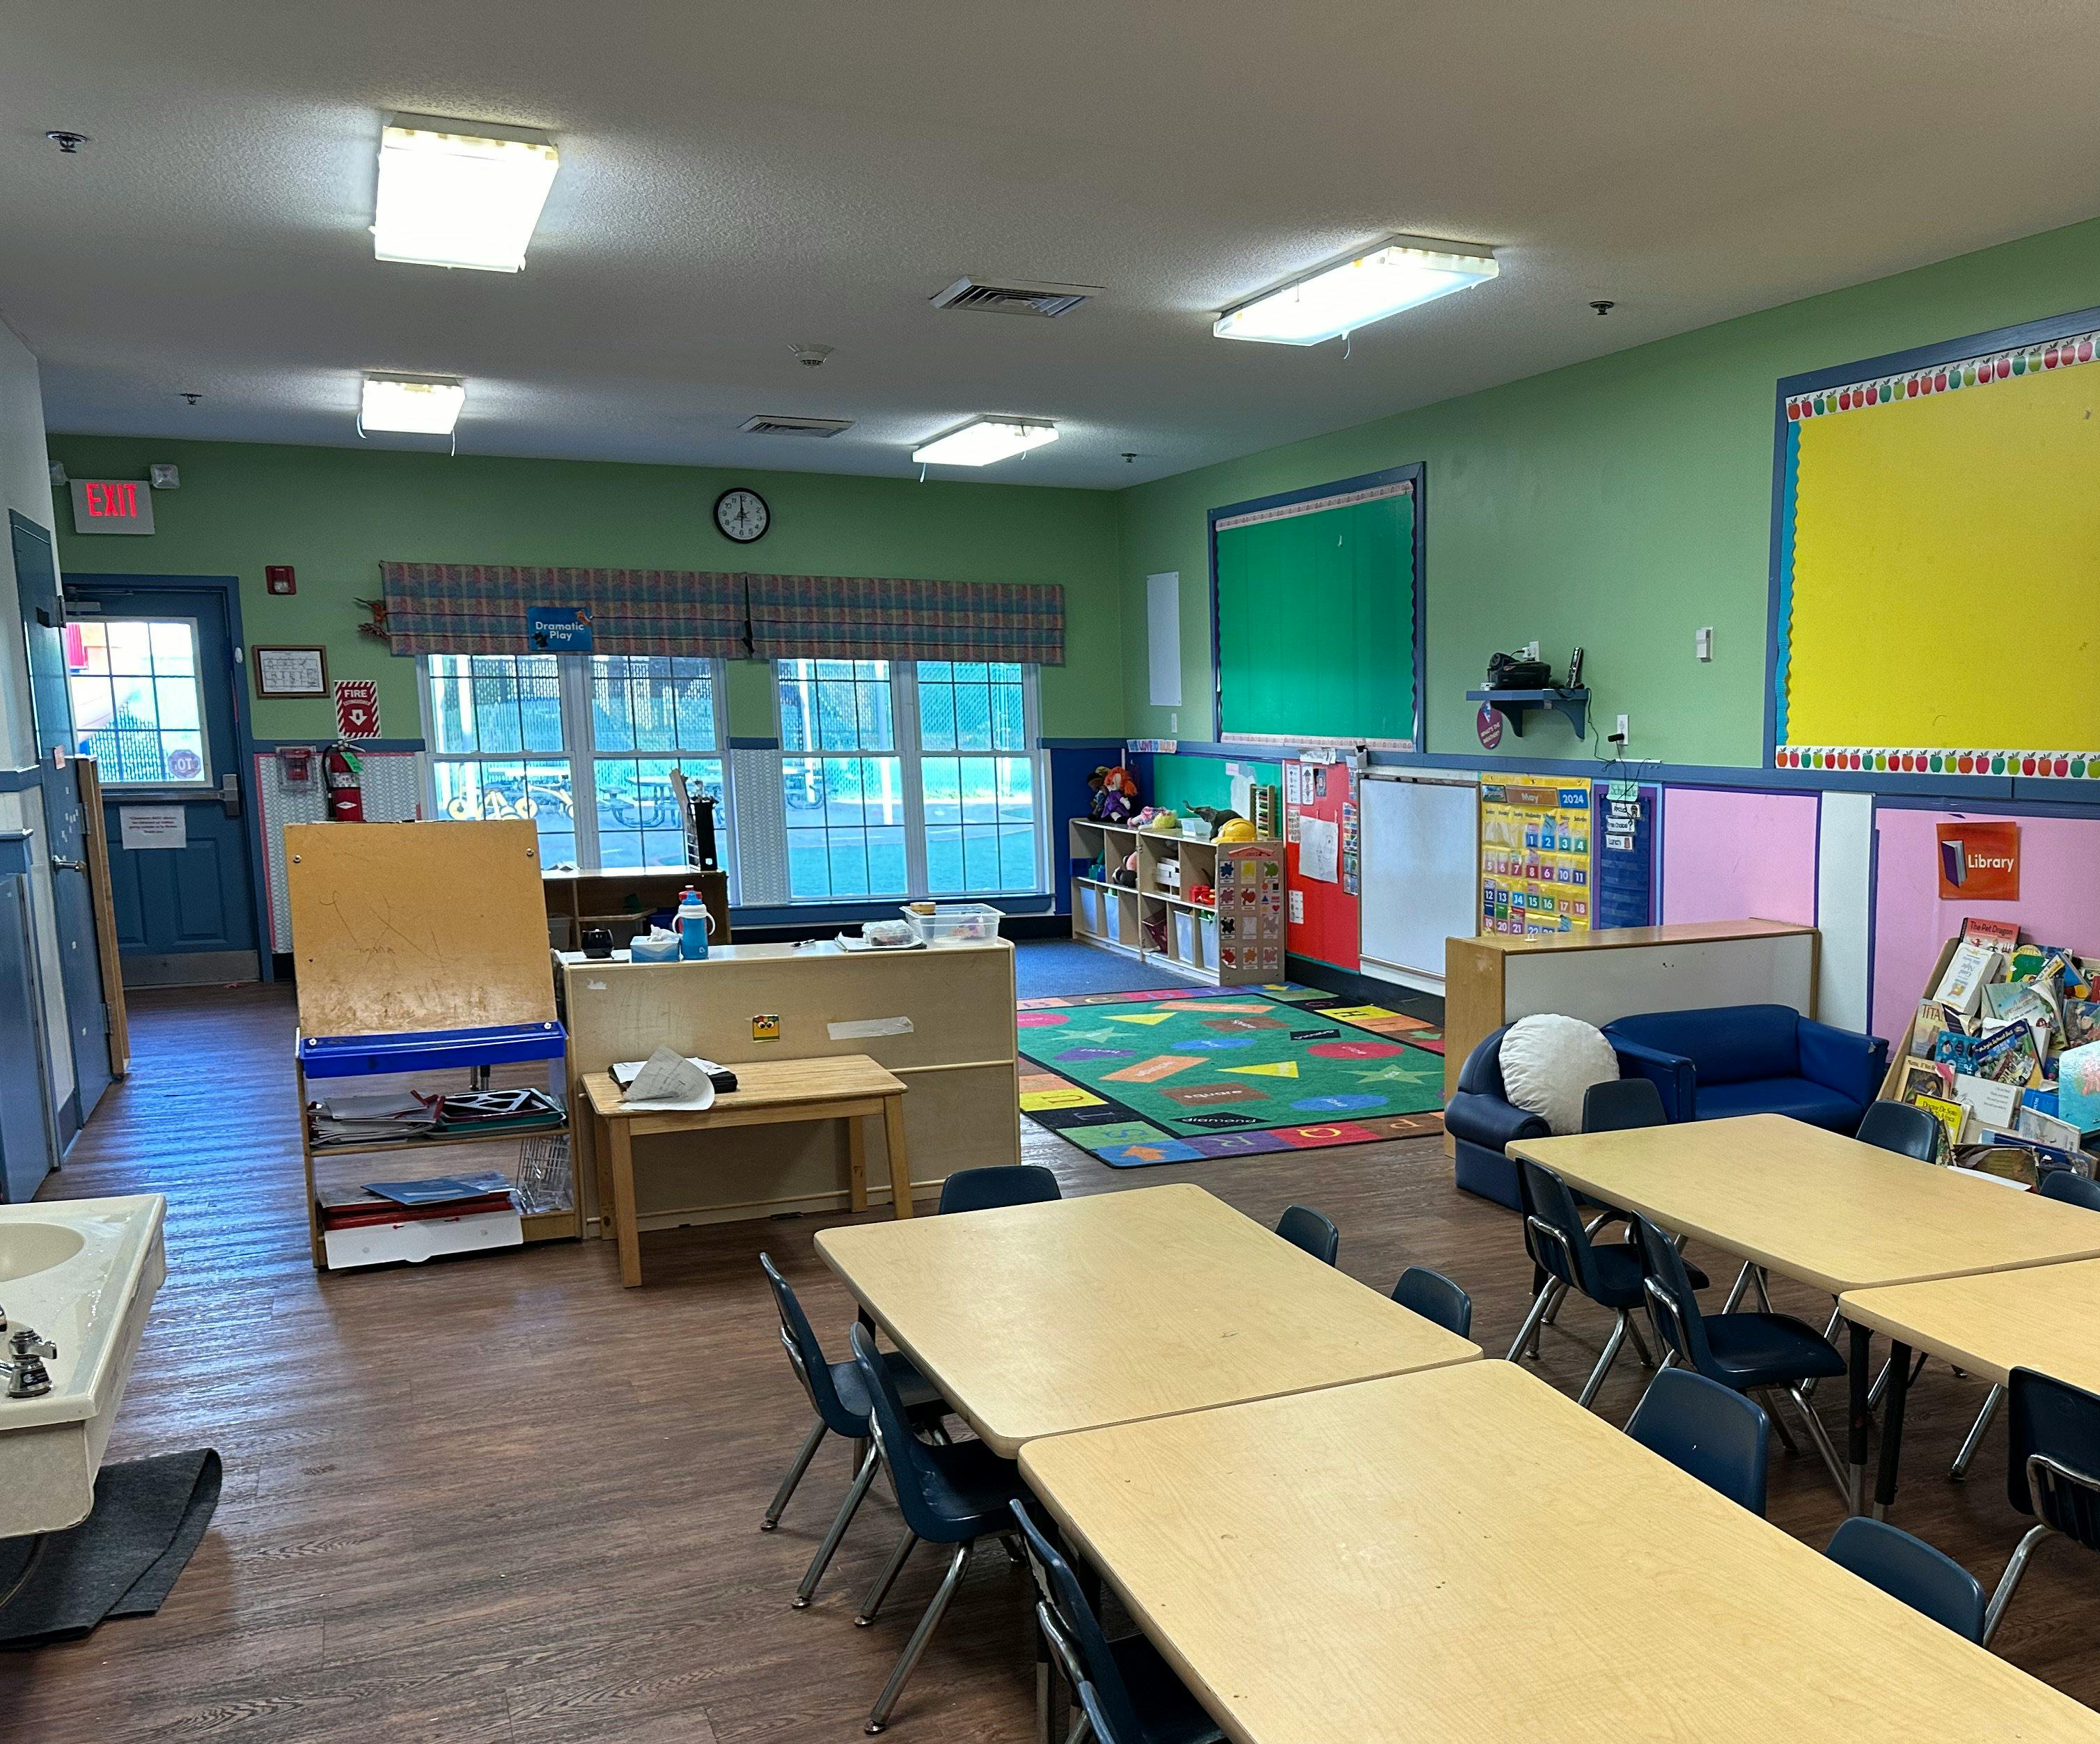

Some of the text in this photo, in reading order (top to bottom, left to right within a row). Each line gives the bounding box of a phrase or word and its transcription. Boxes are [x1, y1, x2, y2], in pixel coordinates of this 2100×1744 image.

[86, 483, 137, 517] EXIT
[535, 621, 585, 630] Dramatic
[549, 630, 572, 641] Play
[344, 689, 368, 698] FIRE
[1138, 740, 1152, 752] LOVE
[1521, 792, 1539, 804] May
[1562, 793, 1584, 804] 2024
[1530, 836, 1584, 851] 1 2 3 4
[1968, 853, 2014, 873] Library
[1487, 861, 1492, 870] 5
[1500, 863, 1505, 873] 6
[1514, 864, 1520, 874] 7
[1529, 867, 1535, 877] 8
[1559, 870, 1569, 881] 10
[1576, 872, 1584, 882] 11
[1485, 890, 1585, 914] 12 13 14 15 16 17 18
[1485, 919, 1493, 927] 19
[1497, 921, 1507, 932] 20
[1512, 924, 1521, 933] 21
[1970, 920, 1981, 931] The
[1982, 923, 1992, 932] Pet
[1991, 925, 2014, 937] Dragon
[1332, 1010, 1370, 1018] H
[1040, 1093, 1084, 1104] U
[1184, 1090, 1242, 1098] square
[1390, 1118, 1425, 1129] P
[1104, 1128, 1150, 1139] S
[1296, 1126, 1342, 1139] Q
[1211, 1135, 1256, 1148] R
